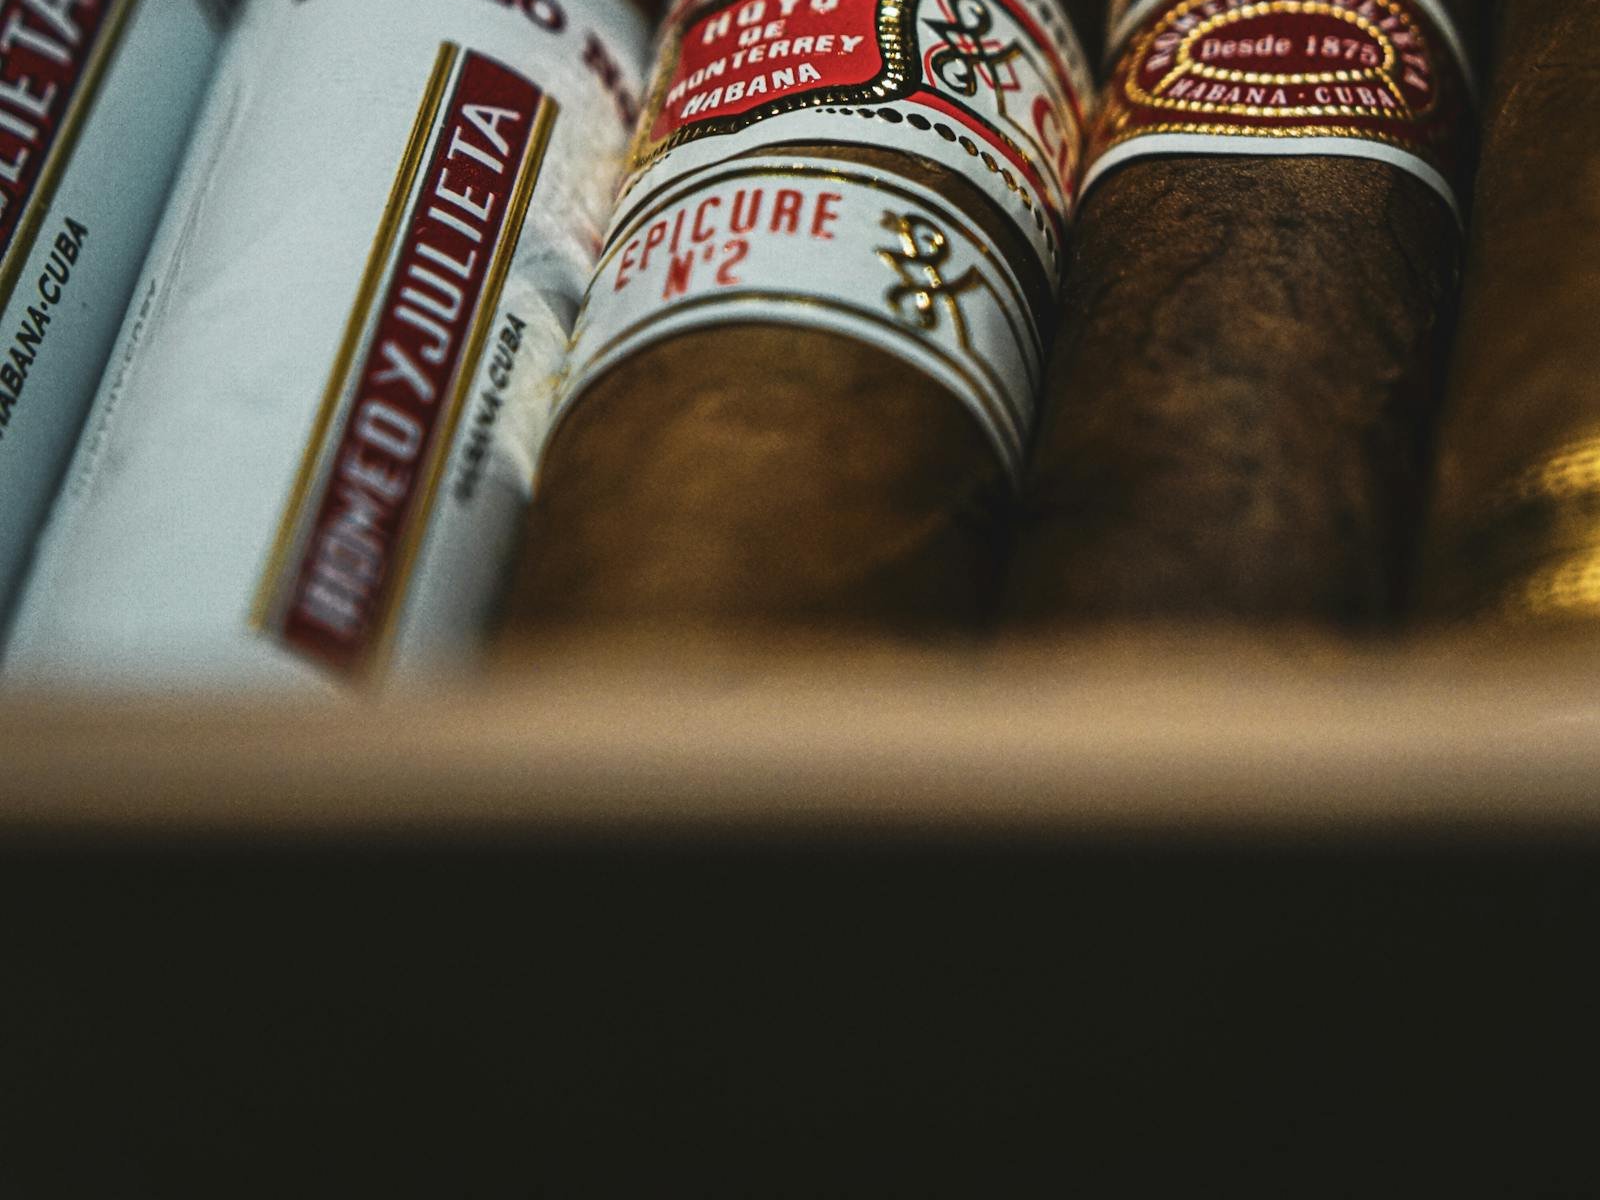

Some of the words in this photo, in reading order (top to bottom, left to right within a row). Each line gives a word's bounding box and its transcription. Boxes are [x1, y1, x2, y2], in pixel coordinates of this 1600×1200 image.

[737, 18, 786, 47] DE
[1201, 34, 1292, 60] Desde
[1305, 35, 1378, 67] 1875
[665, 34, 864, 107] MONTERREY
[680, 61, 822, 119] HABANA
[1167, 79, 1287, 105] HABANA
[1314, 86, 1396, 109] CUBA
[394, 102, 522, 363] JULIETA
[614, 188, 843, 293] EPICURE
